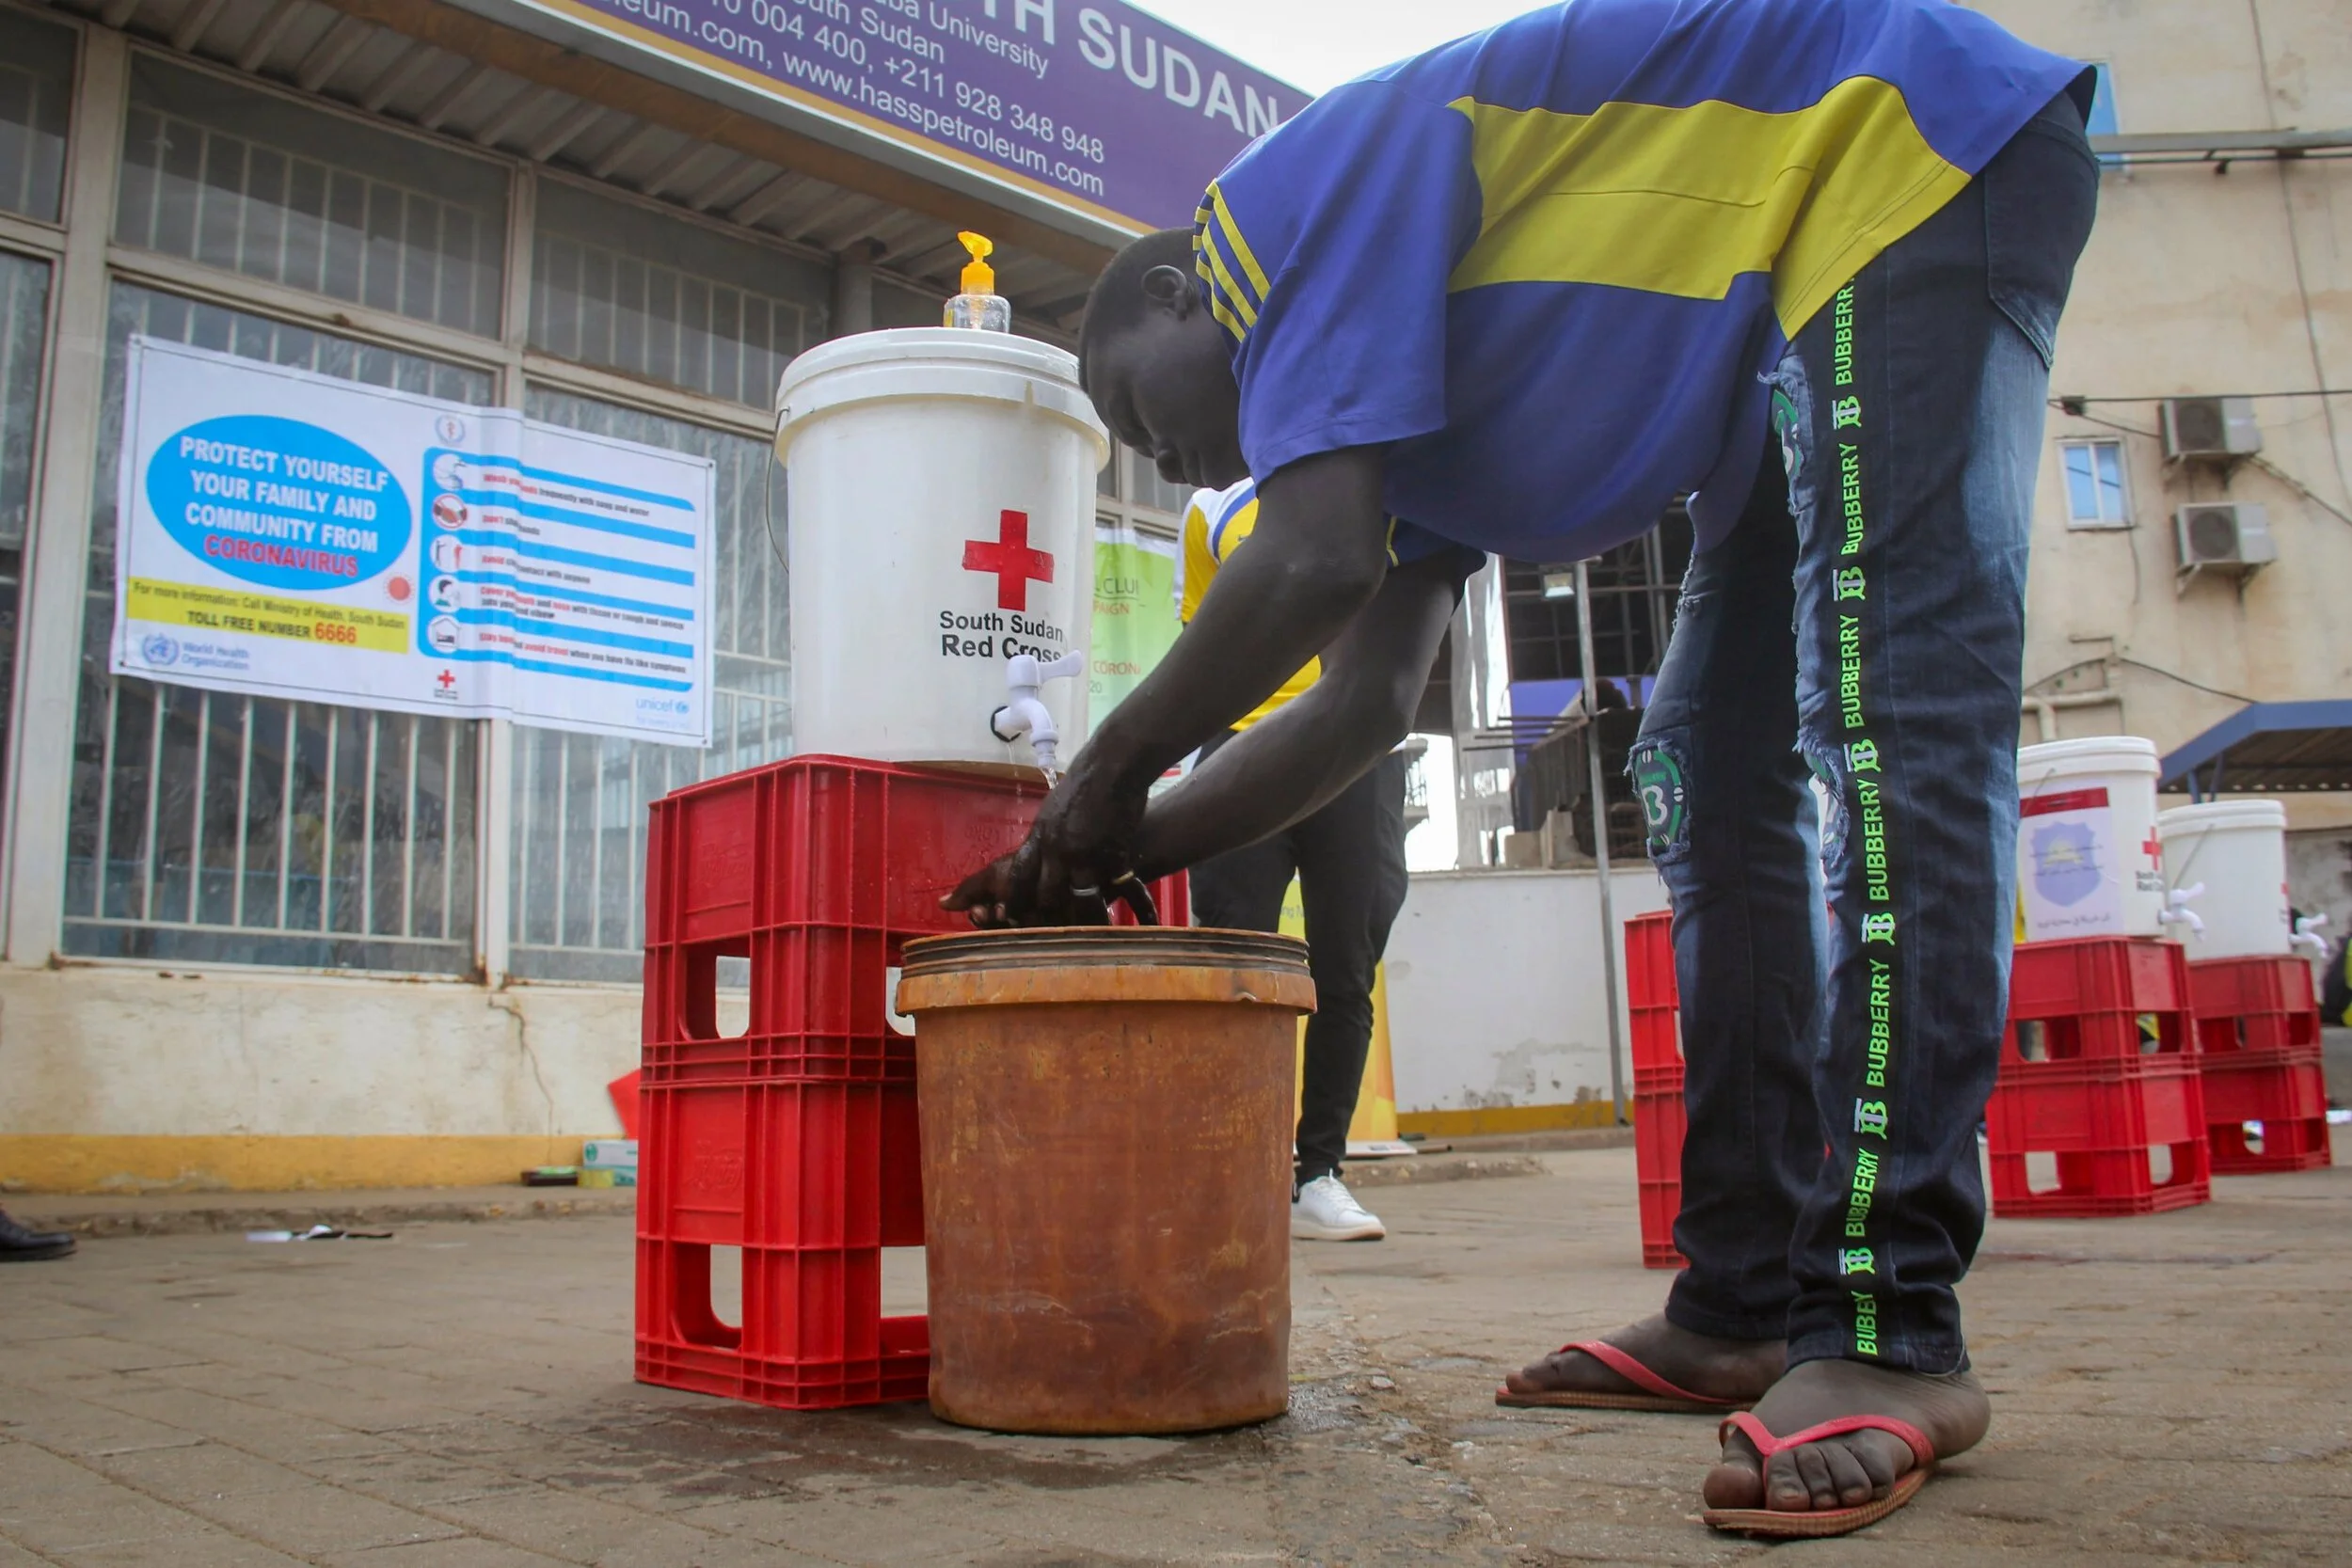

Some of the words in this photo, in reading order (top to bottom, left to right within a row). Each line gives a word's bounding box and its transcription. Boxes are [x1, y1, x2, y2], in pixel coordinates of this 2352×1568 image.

[861, 8, 945, 64] Sudan
[929, 2, 1049, 79] University
[752, 0, 804, 40] 004
[814, 24, 873, 73] 400,
[884, 57, 944, 98] +211
[956, 82, 1002, 121] 928
[1009, 104, 1055, 142] 348
[1061, 126, 1104, 164] 948
[1078, 8, 1279, 138] SUDAN
[783, 52, 1104, 197] www.hasspetroleum.com
[1836, 277, 1855, 386] BUBBERR
[180, 436, 278, 473] PROTECT
[283, 454, 389, 492] YOURSELF
[190, 469, 250, 500] YOUR
[255, 481, 329, 514] FAMILY
[333, 495, 376, 521] AND
[1838, 443, 1864, 556] BUBBERRY
[185, 502, 316, 543] COMMUNITY
[321, 524, 378, 553] FROM
[204, 534, 358, 577] CORONAVIRUS
[134, 581, 151, 594] For
[153, 587, 179, 598] more
[243, 596, 261, 610] Call
[264, 600, 300, 617] Ministry
[303, 606, 312, 616] of
[349, 611, 373, 625] South
[377, 615, 405, 629] Sudan
[1104, 578, 1139, 594] CLU
[183, 641, 214, 655] World
[216, 645, 249, 658] Health
[187, 610, 219, 626] TOLL
[223, 614, 254, 631] FREE
[259, 619, 310, 638] NUMBER
[314, 621, 357, 643] 6666
[940, 610, 1004, 631] South
[1010, 614, 1063, 642] Sudan
[942, 634, 993, 657] Red
[1093, 660, 1141, 675] CORON
[1839, 613, 1866, 729] BUBBERRY
[636, 697, 674, 712] unicef
[1856, 779, 1890, 901] BUBBERRY
[1866, 958, 1890, 1087] BUBBERRY
